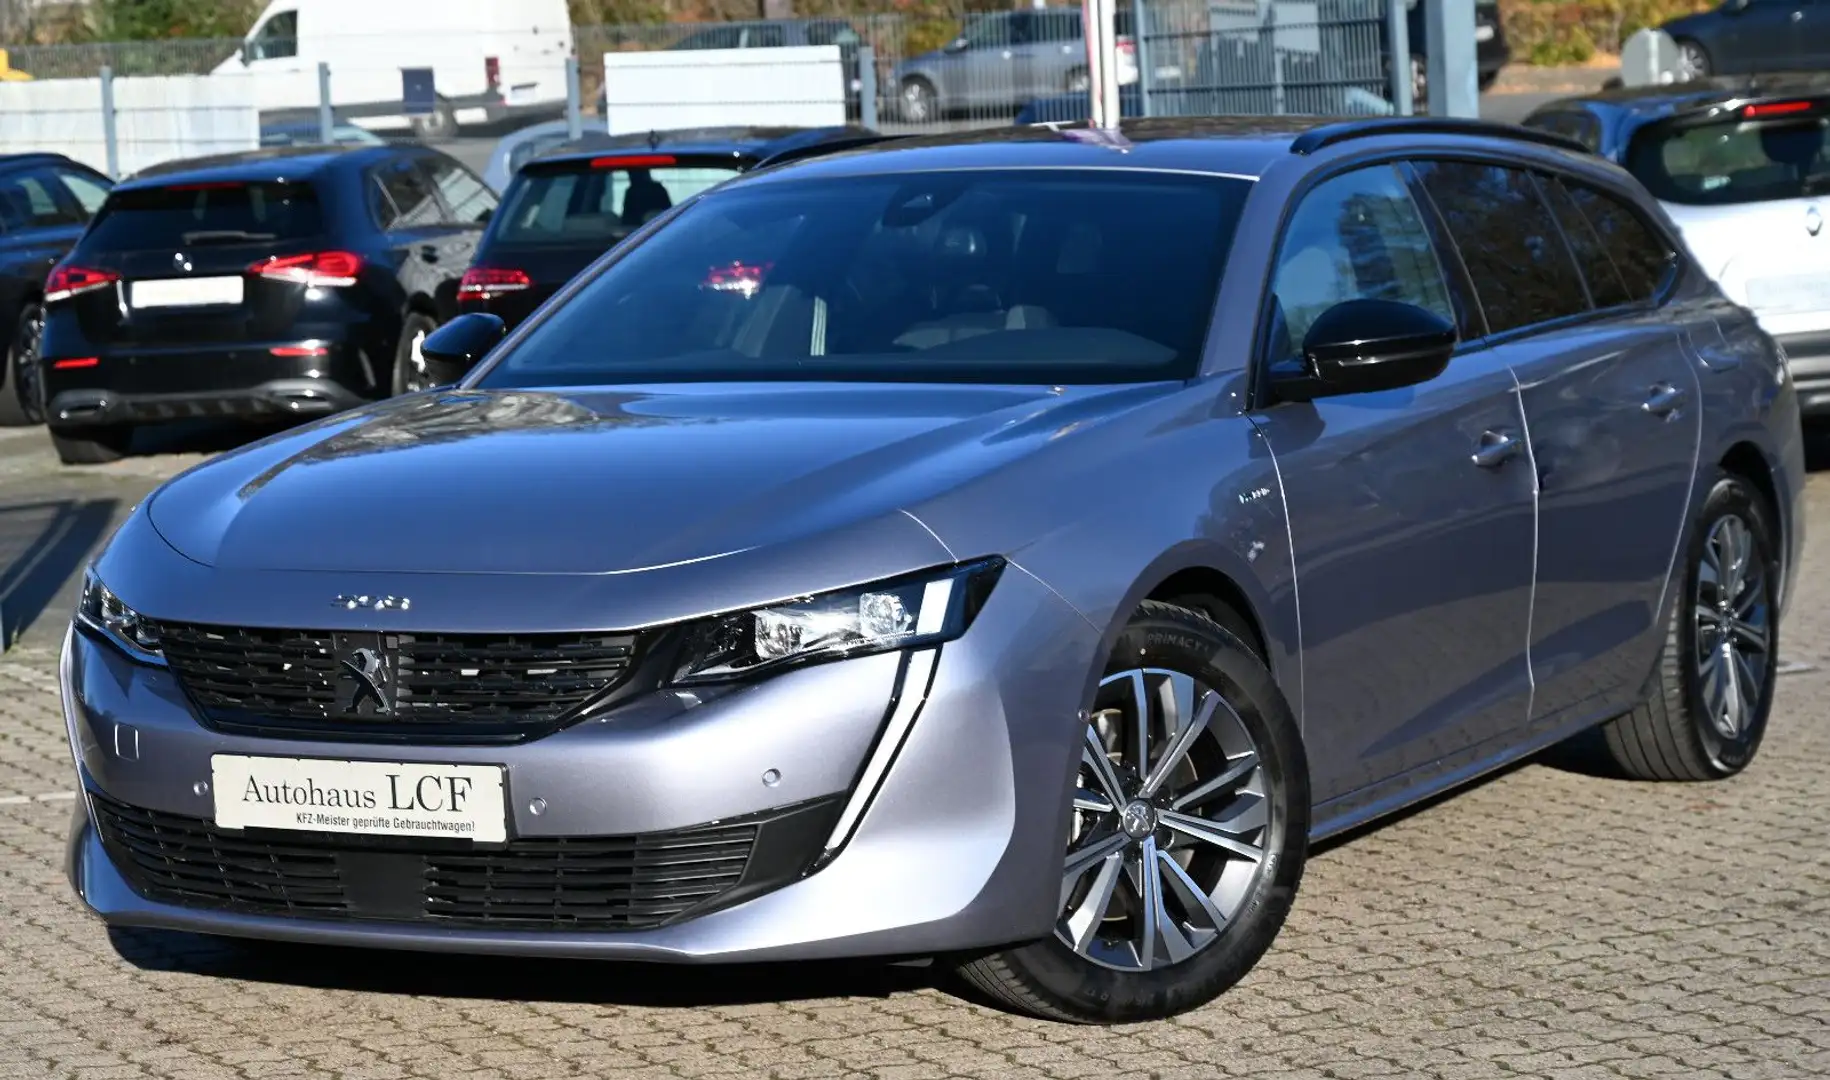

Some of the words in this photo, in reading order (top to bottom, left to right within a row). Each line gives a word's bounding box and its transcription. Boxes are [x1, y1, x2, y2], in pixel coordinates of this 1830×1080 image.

[242, 774, 377, 809] Autohaus
[385, 774, 473, 812] LCF
[296, 812, 350, 827] KFZ-Meister
[352, 816, 391, 830] geprüfte
[393, 817, 476, 834] Gebrauchtwagen!
